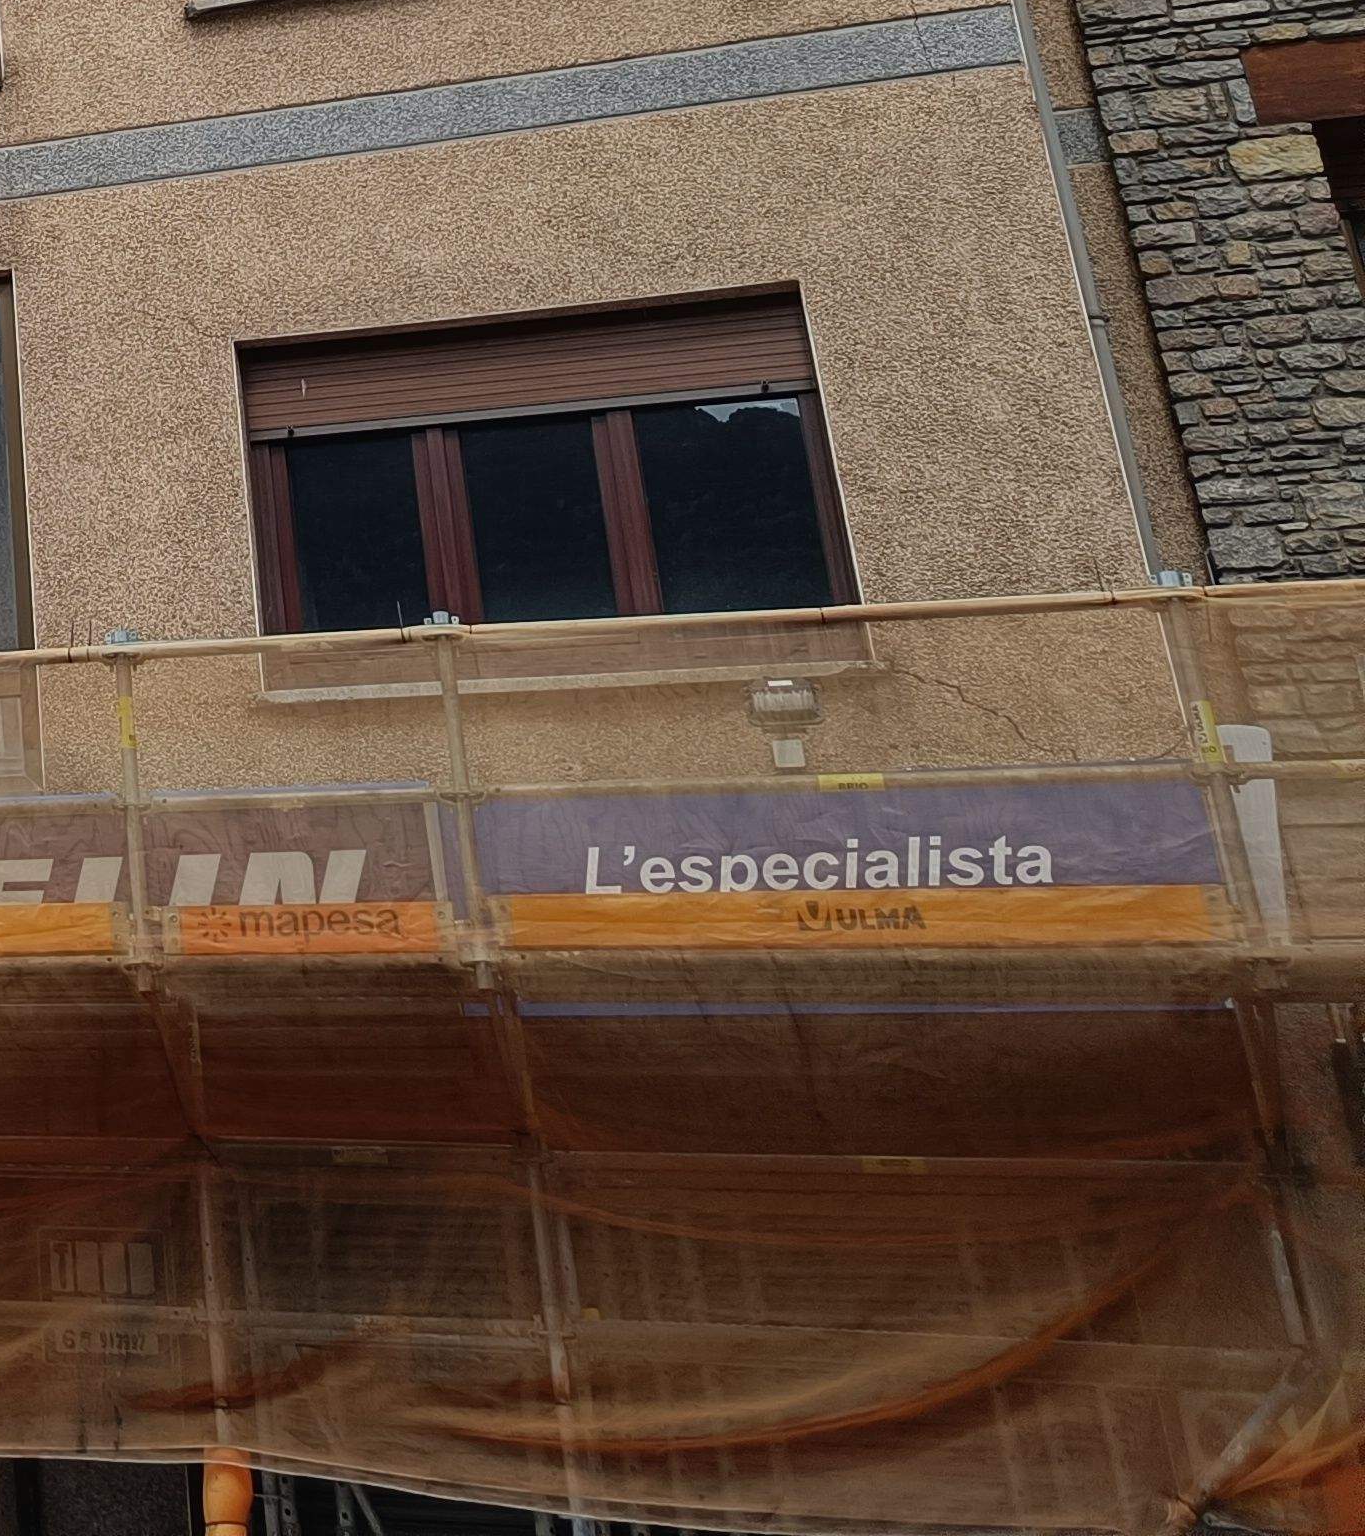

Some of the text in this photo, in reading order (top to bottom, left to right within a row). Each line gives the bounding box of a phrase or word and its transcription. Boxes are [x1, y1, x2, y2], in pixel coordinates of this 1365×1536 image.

[585, 835, 1054, 895] L'especialista
[239, 908, 401, 943] mapesa
[835, 905, 927, 931] ULMA
